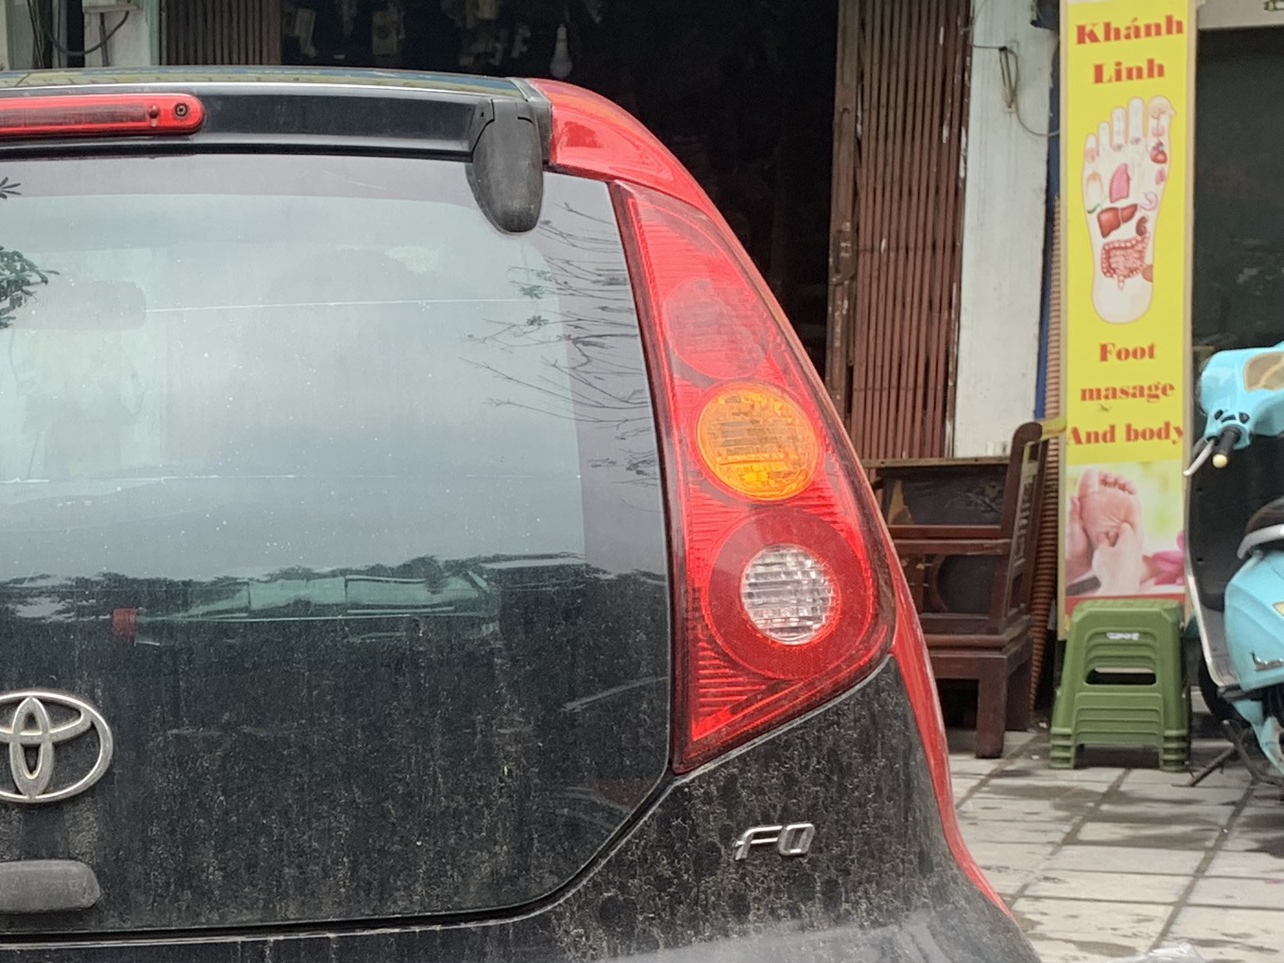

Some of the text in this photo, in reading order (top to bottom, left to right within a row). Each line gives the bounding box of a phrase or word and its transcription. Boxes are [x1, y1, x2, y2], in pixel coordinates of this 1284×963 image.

[1075, 14, 1184, 46] Khánh
[1093, 58, 1165, 85] Linh
[1098, 342, 1155, 363] Foot
[1080, 381, 1175, 404] masage
[1066, 421, 1185, 446] And body
